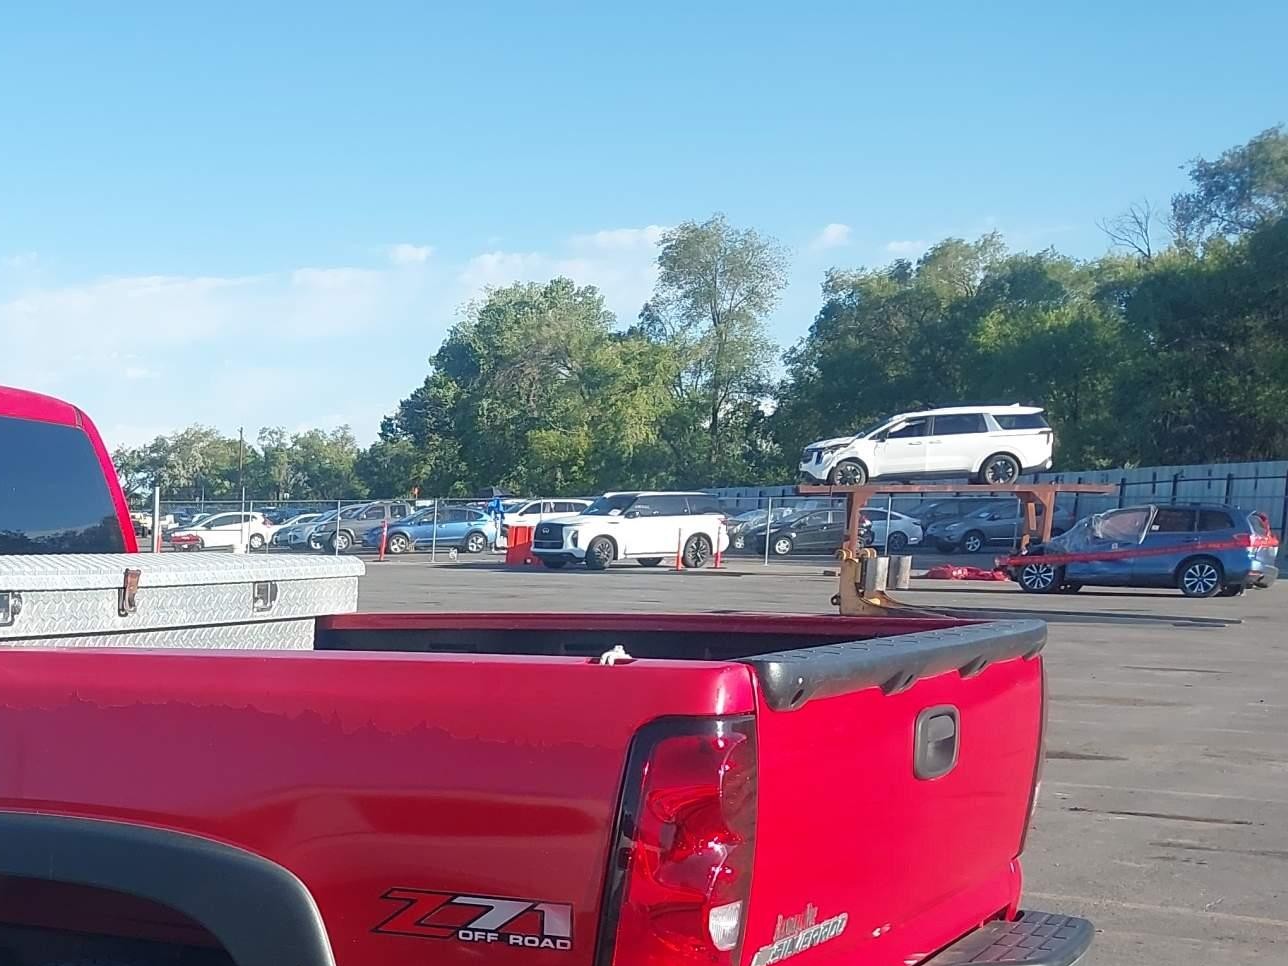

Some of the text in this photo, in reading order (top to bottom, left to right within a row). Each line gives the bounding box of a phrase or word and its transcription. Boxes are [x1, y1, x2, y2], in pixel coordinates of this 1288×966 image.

[372, 887, 574, 939] Z71
[458, 929, 572, 950] OFF ROAD
